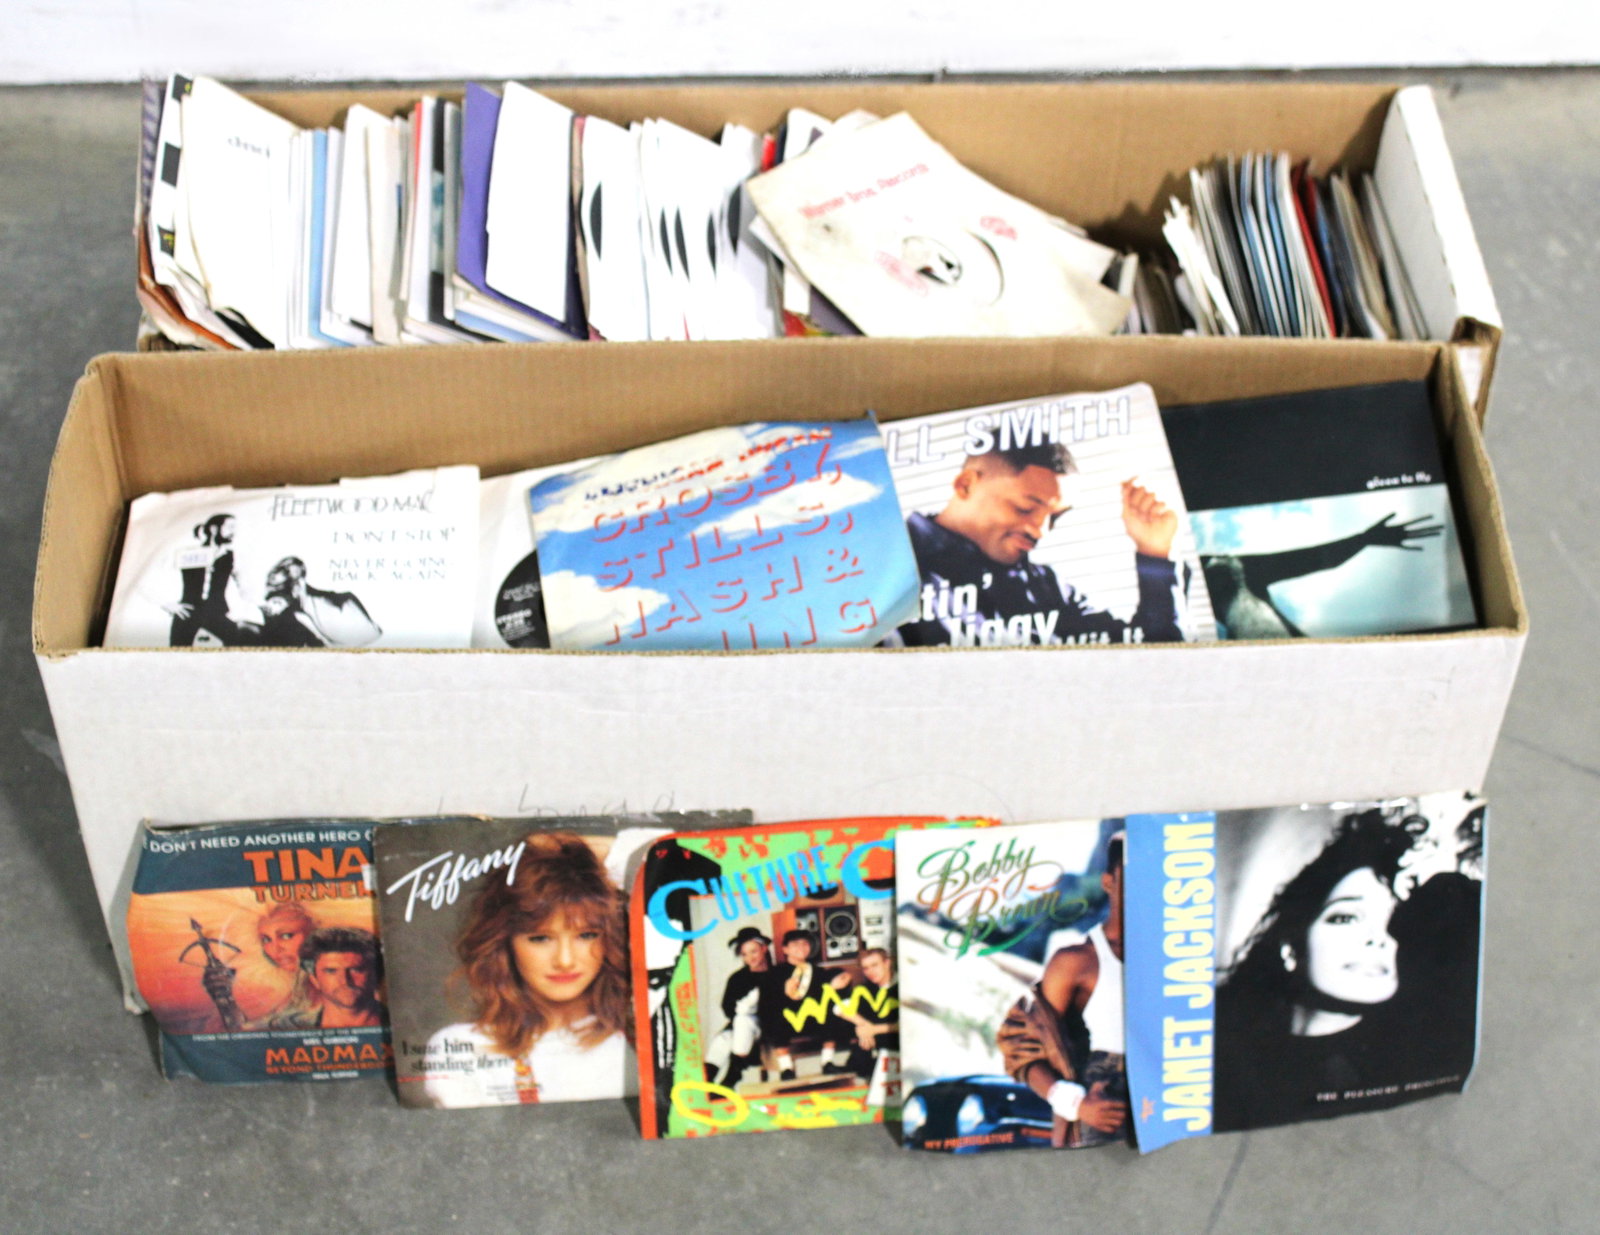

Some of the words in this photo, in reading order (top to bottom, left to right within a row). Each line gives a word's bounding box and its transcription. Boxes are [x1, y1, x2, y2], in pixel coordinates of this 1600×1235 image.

[886, 423, 946, 467] LL
[963, 396, 1130, 456] SMITH
[270, 492, 388, 522] FLEETWOOD
[405, 525, 456, 543] STOP
[329, 556, 386, 570] NEVER
[331, 570, 378, 582] BACK
[391, 568, 446, 581] AGAIN
[820, 546, 865, 583] &
[150, 835, 196, 854] DON'T
[200, 834, 240, 850] NEED
[244, 830, 315, 847] ANOTHER
[319, 829, 360, 843] HERO
[243, 846, 371, 883] TINA
[386, 841, 527, 923] Tiffany
[917, 837, 1064, 916] Bobby
[647, 845, 838, 941] CULTURE
[943, 877, 1089, 961] Brown
[1163, 821, 1215, 1010] JACKSON
[264, 1047, 330, 1066] MAD
[402, 1039, 408, 1055] I
[444, 1038, 474, 1053] him
[411, 1055, 475, 1075] standing
[1162, 1015, 1212, 1132] JANET
